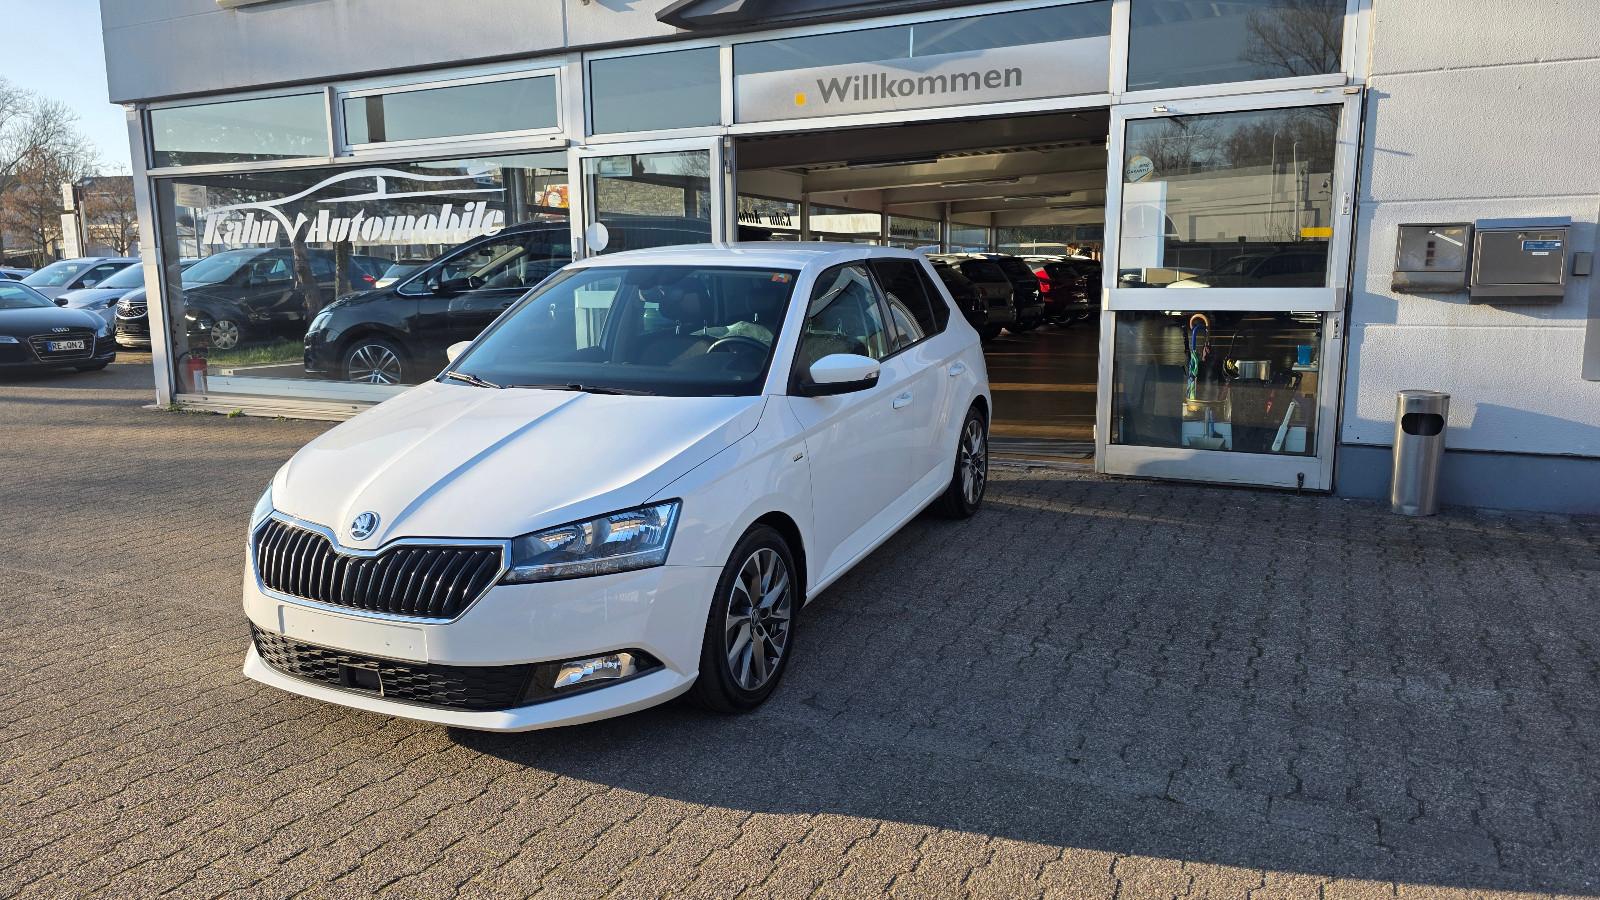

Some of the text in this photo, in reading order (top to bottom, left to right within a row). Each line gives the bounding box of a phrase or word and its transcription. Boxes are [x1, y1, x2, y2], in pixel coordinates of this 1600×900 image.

[816, 66, 1022, 104] Willkommen
[203, 201, 505, 244] Kahn Automobile
[52, 342, 63, 350] RE
